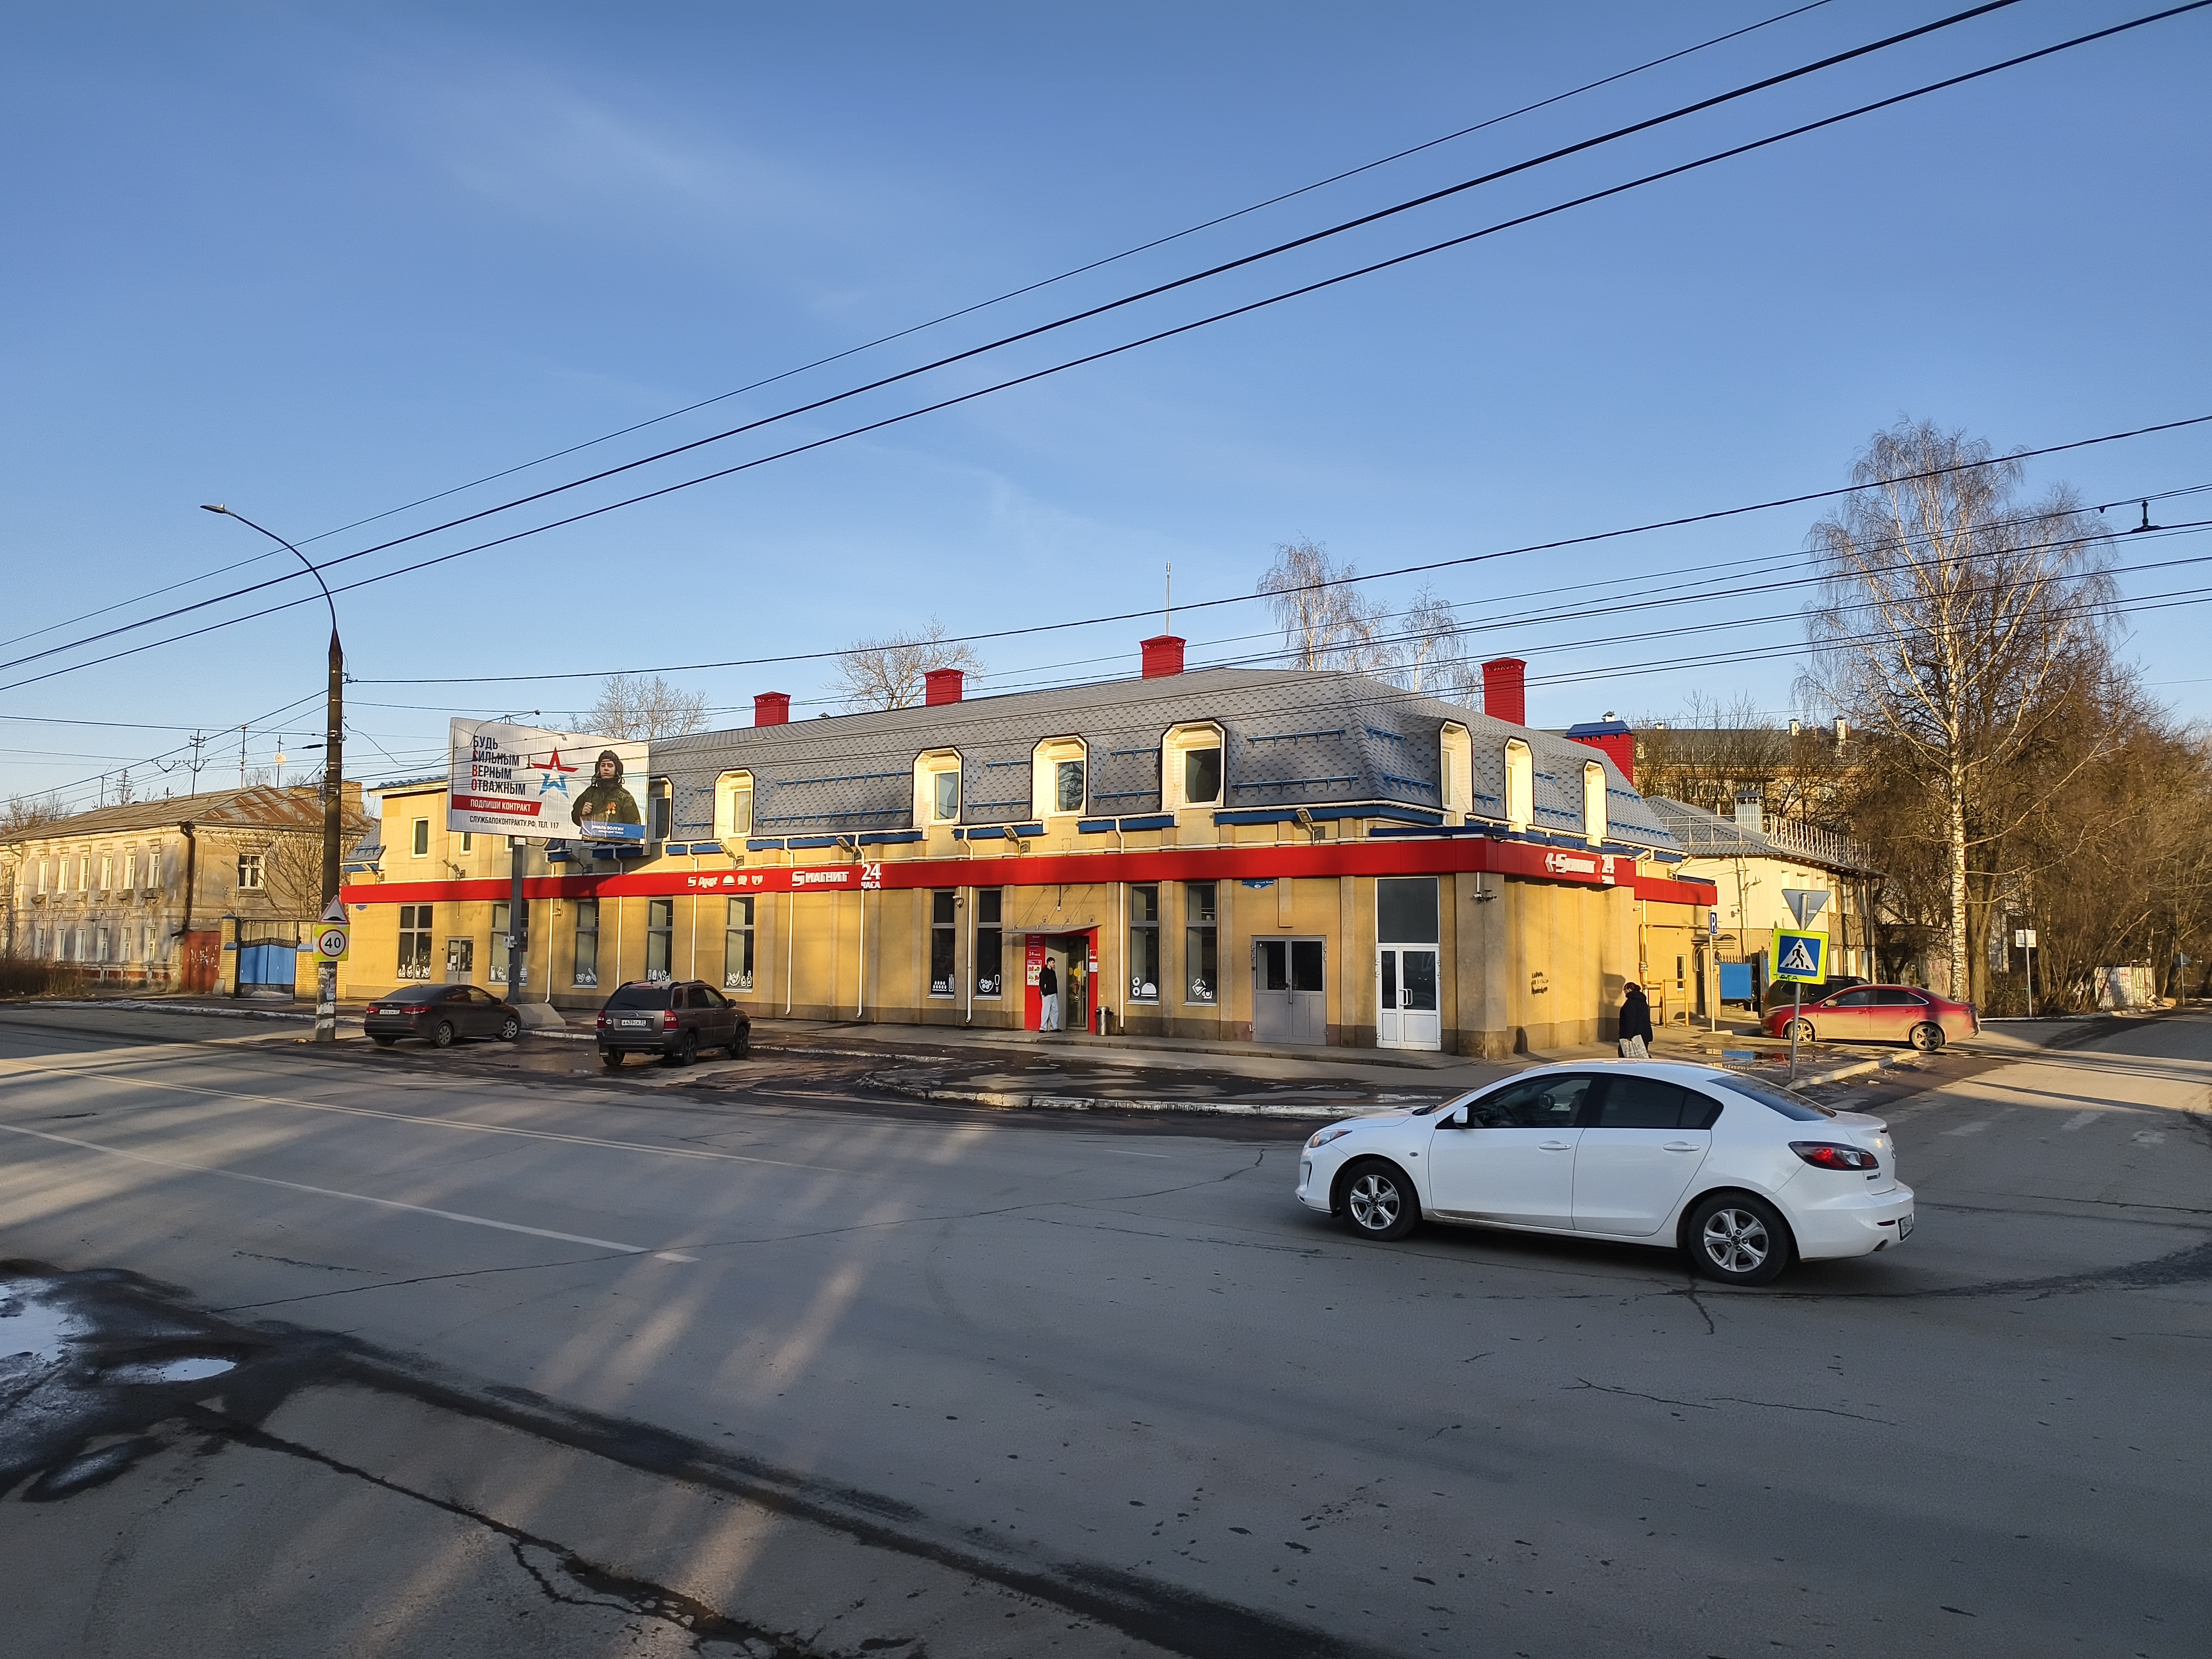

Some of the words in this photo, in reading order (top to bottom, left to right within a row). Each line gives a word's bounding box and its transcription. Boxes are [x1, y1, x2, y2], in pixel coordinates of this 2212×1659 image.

[473, 734, 498, 751] БУДЬ
[473, 750, 520, 766] СИЛЬНЫМ
[472, 764, 511, 780] ВЕРНЫМ
[471, 779, 525, 795] ОТВАЖНЫМ
[470, 799, 501, 810] ПОДПИШИ
[502, 801, 531, 812] КОНТРАКТ
[1601, 854, 1615, 874] 24
[805, 871, 849, 883] МАГНИТ
[861, 863, 882, 881] 24
[325, 937, 341, 949] 40
